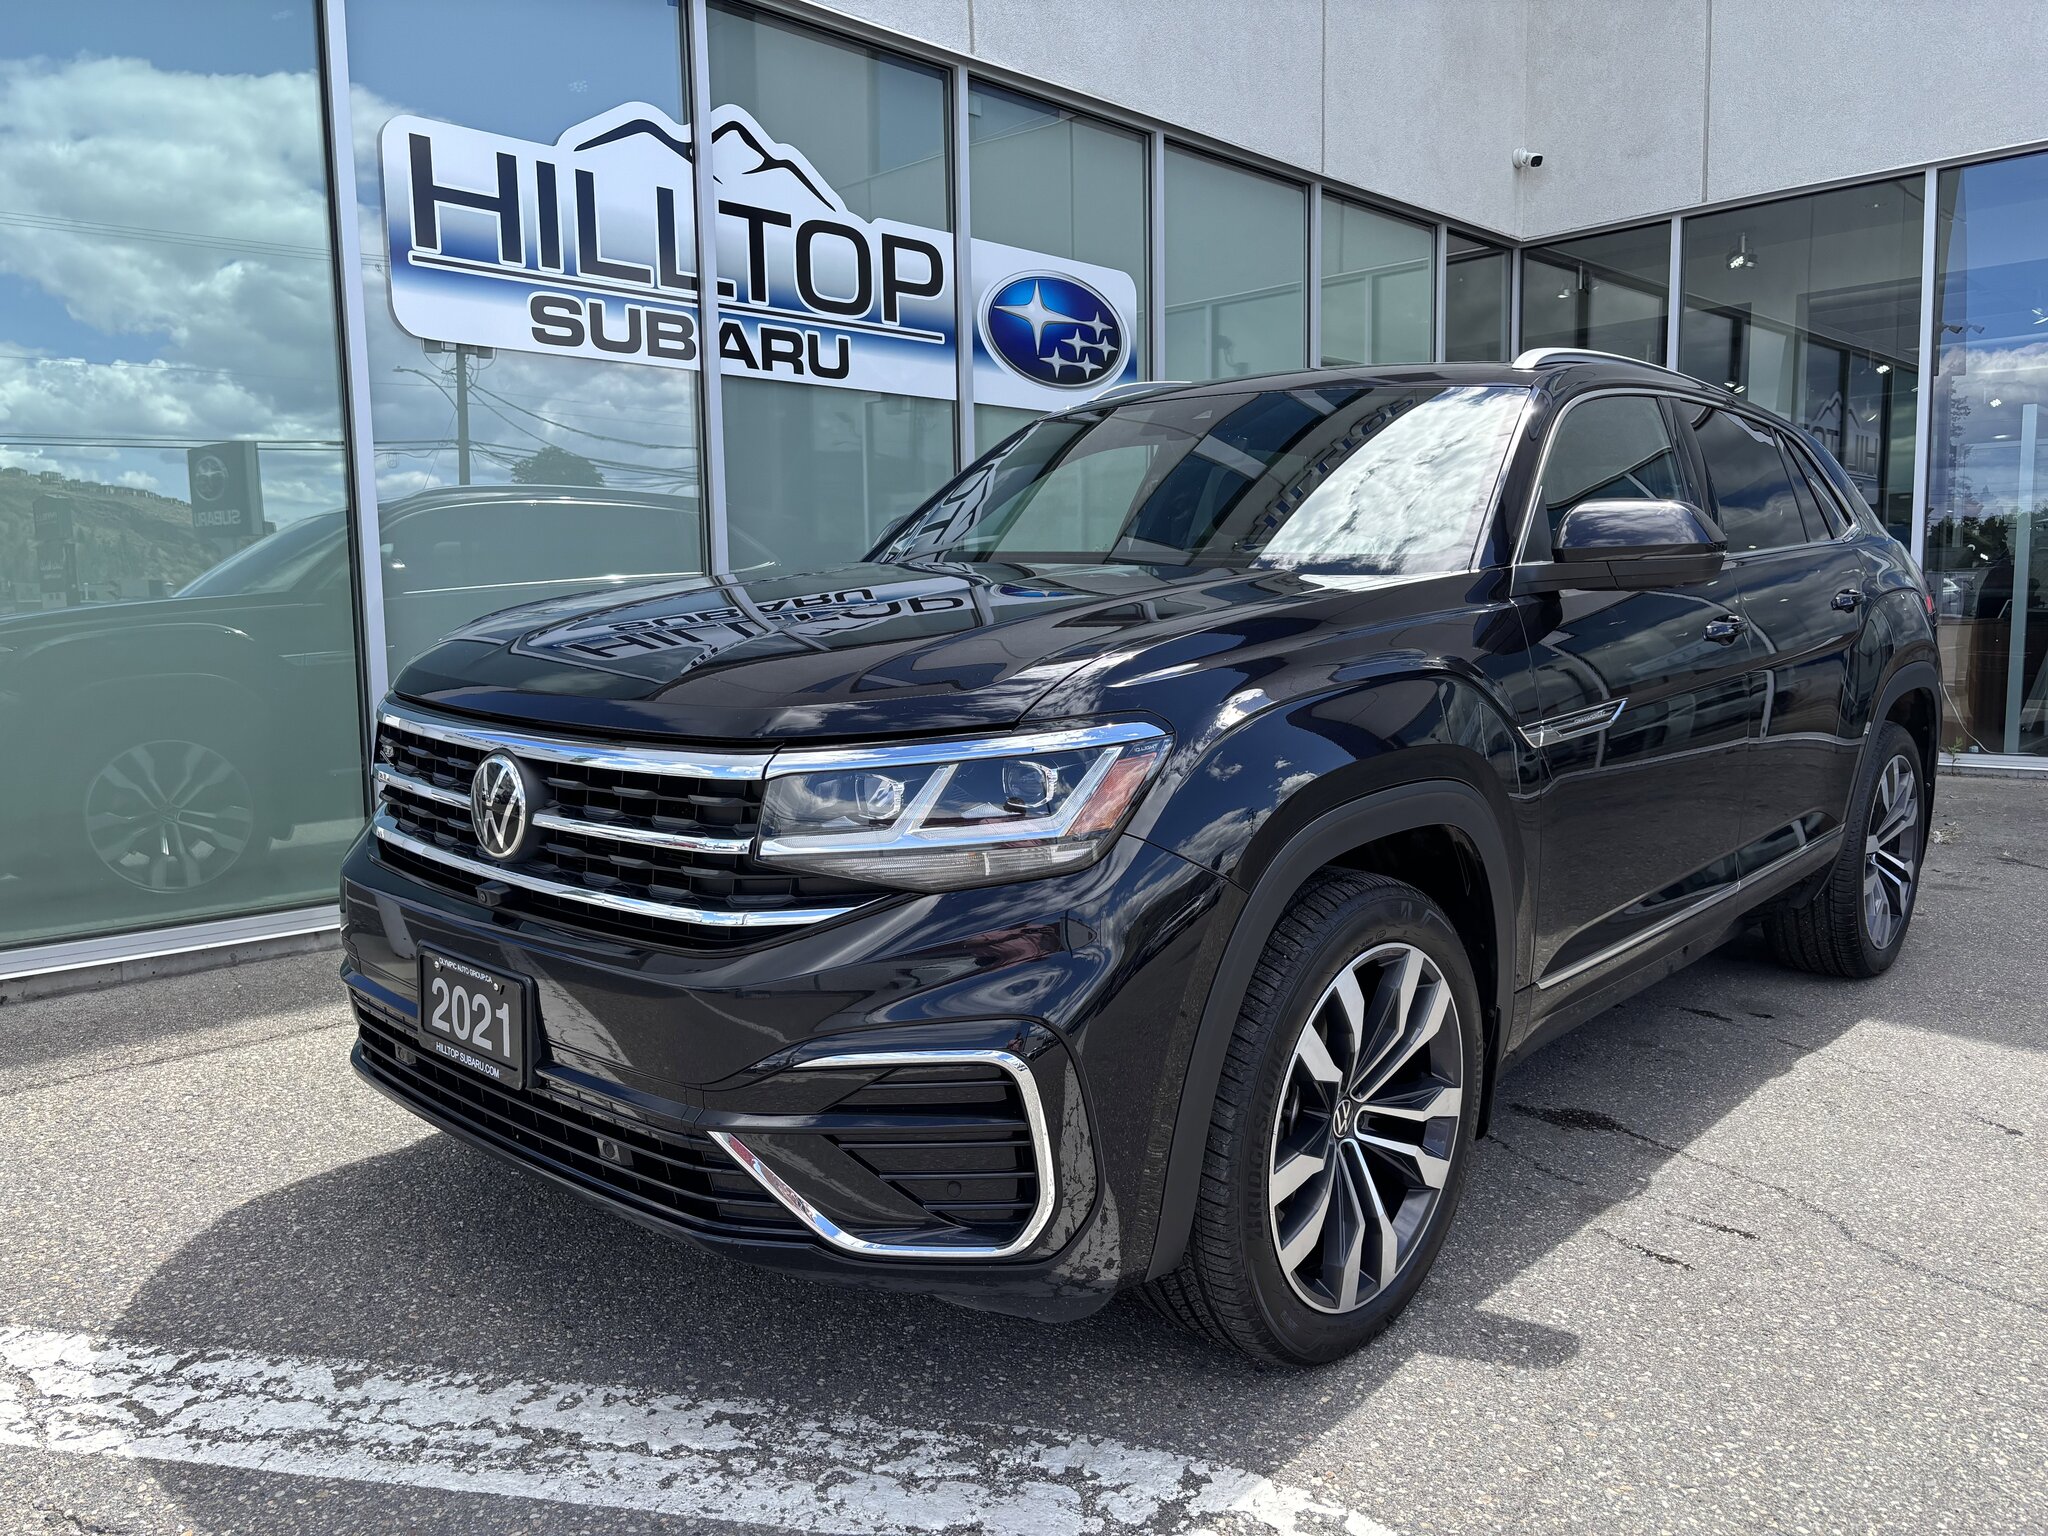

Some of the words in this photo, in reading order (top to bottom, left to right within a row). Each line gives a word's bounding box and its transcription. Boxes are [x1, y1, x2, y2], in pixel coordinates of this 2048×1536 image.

[407, 132, 944, 323] HILLTOP
[530, 294, 851, 380] SUBARU
[431, 977, 511, 1058] 2021
[435, 1041, 460, 1059] HILLTOP
[459, 1052, 500, 1078] SUBARU.COM
